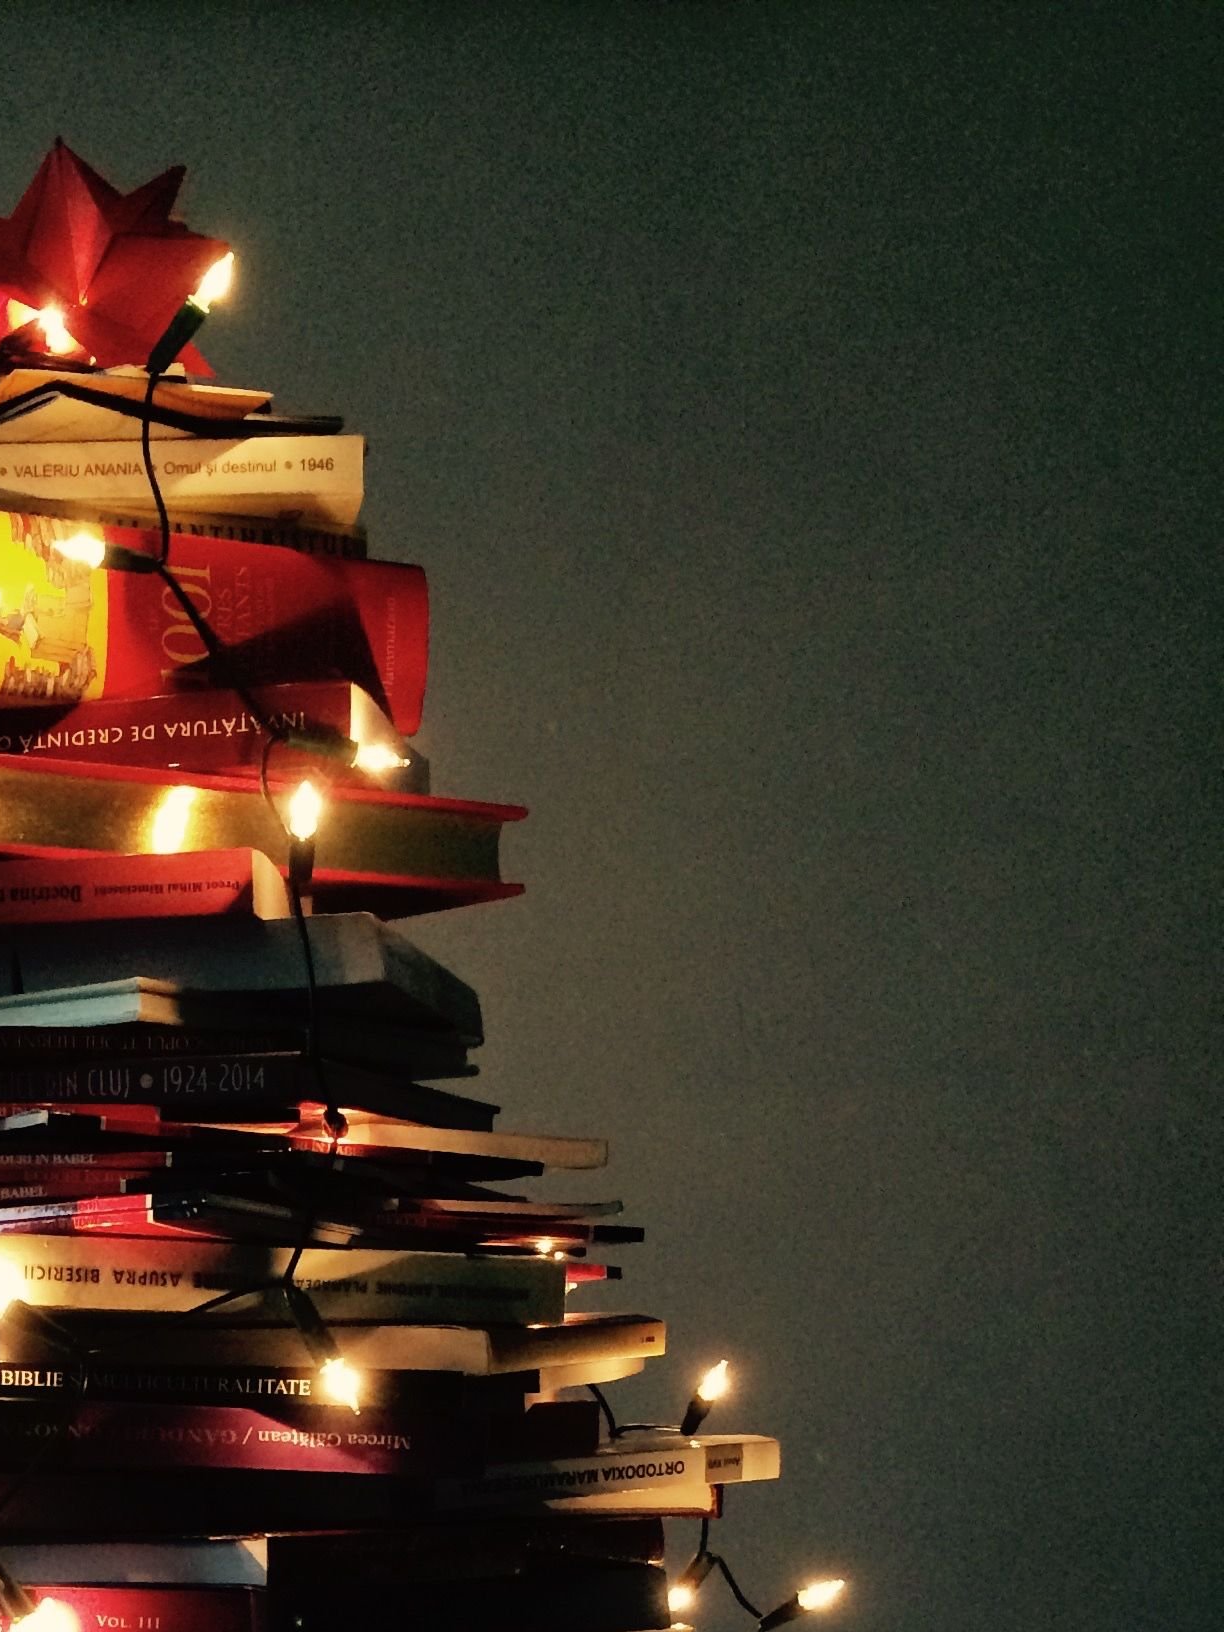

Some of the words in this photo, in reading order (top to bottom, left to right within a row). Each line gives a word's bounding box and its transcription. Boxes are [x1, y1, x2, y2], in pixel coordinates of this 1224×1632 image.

[13, 463, 80, 478] VALERIU
[84, 462, 143, 476] ANANIA
[163, 461, 203, 475] Omul
[221, 460, 277, 475] destinul
[299, 456, 335, 472] 1946
[131, 723, 155, 743] DE
[10, 885, 82, 904] Doctrina
[87, 1067, 130, 1099] CLUJ
[162, 1062, 265, 1093] 1924-2014
[52, 1152, 97, 1165] BABEL
[0, 1185, 48, 1200] BABEL
[23, 1264, 100, 1285] BISERICII
[111, 1269, 182, 1288] ASUPRA
[0, 1369, 64, 1388] BIBLIE
[257, 1429, 342, 1449] Gălățean
[346, 1432, 411, 1451] Mircea
[601, 1460, 685, 1483] ORTODOXIA
[96, 1614, 132, 1629] VOL.
[138, 1615, 161, 1630] III
